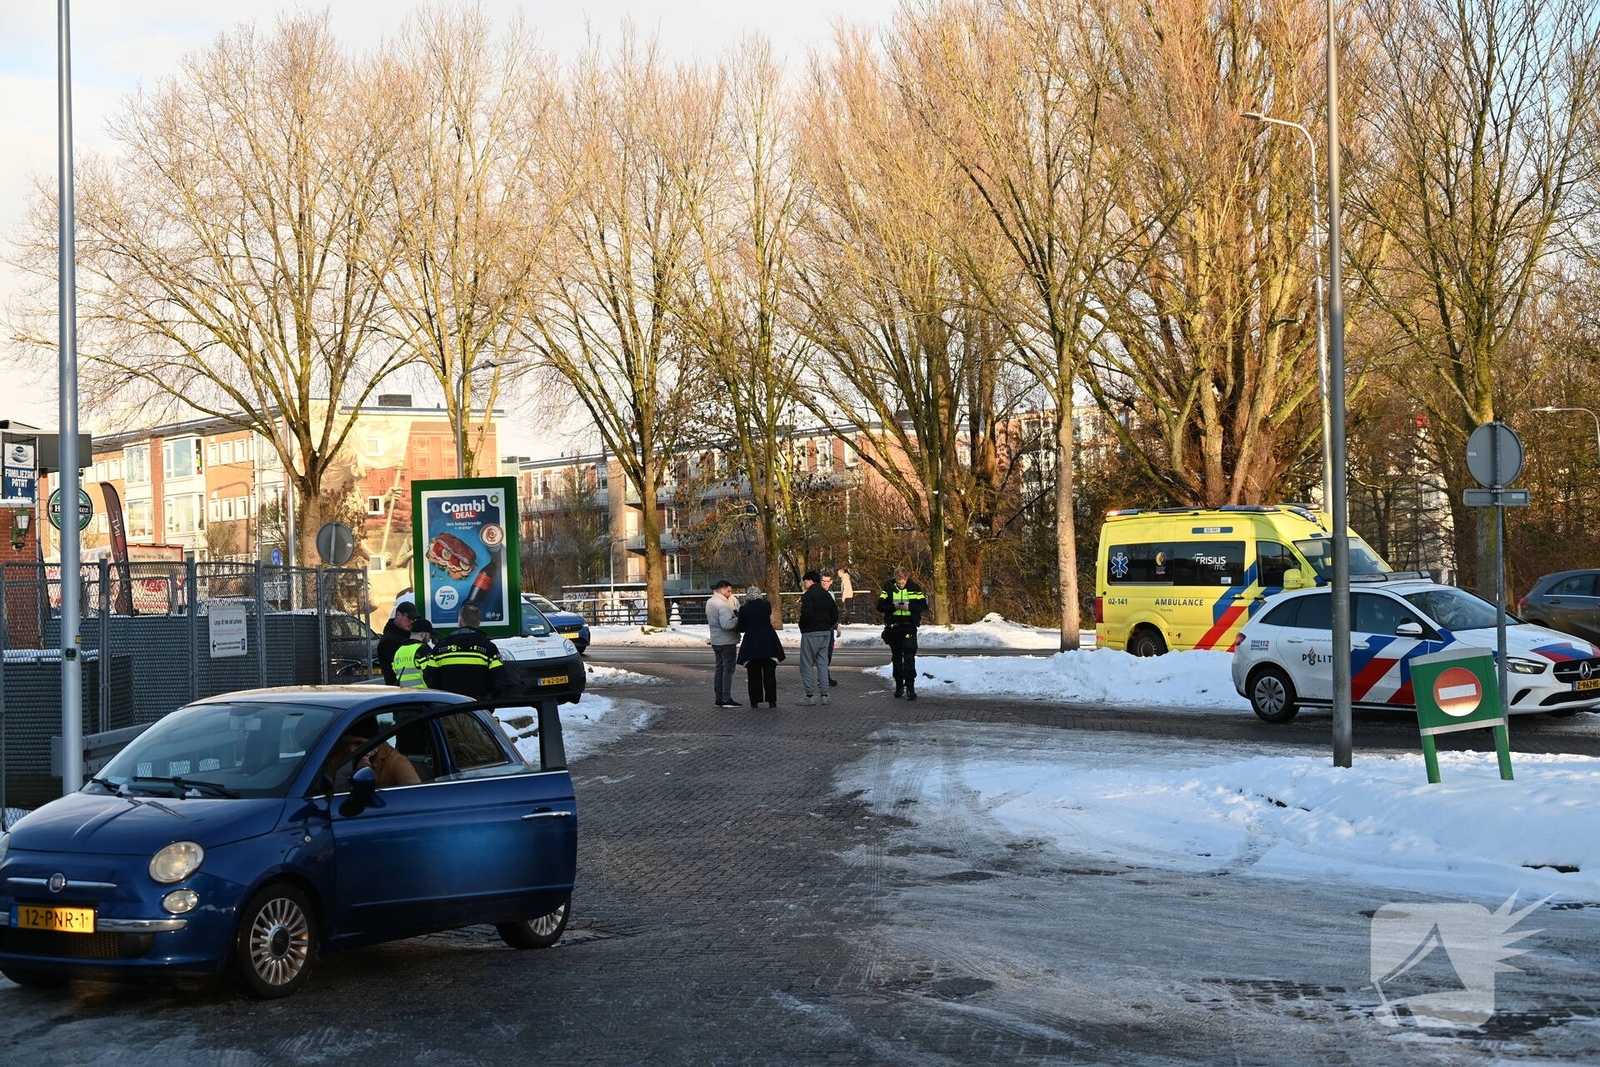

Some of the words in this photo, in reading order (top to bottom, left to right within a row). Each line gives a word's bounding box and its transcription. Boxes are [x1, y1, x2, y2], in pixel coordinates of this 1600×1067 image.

[11, 478, 28, 488] PATAT
[441, 499, 486, 514] Combi
[455, 510, 475, 520] DEAL
[1107, 598, 1128, 606] 02-141
[1154, 598, 1204, 607] AMBULANCE
[1260, 640, 1270, 648] 112
[1302, 652, 1333, 666] POLIT
[25, 908, 85, 929] 12-PNR-1
